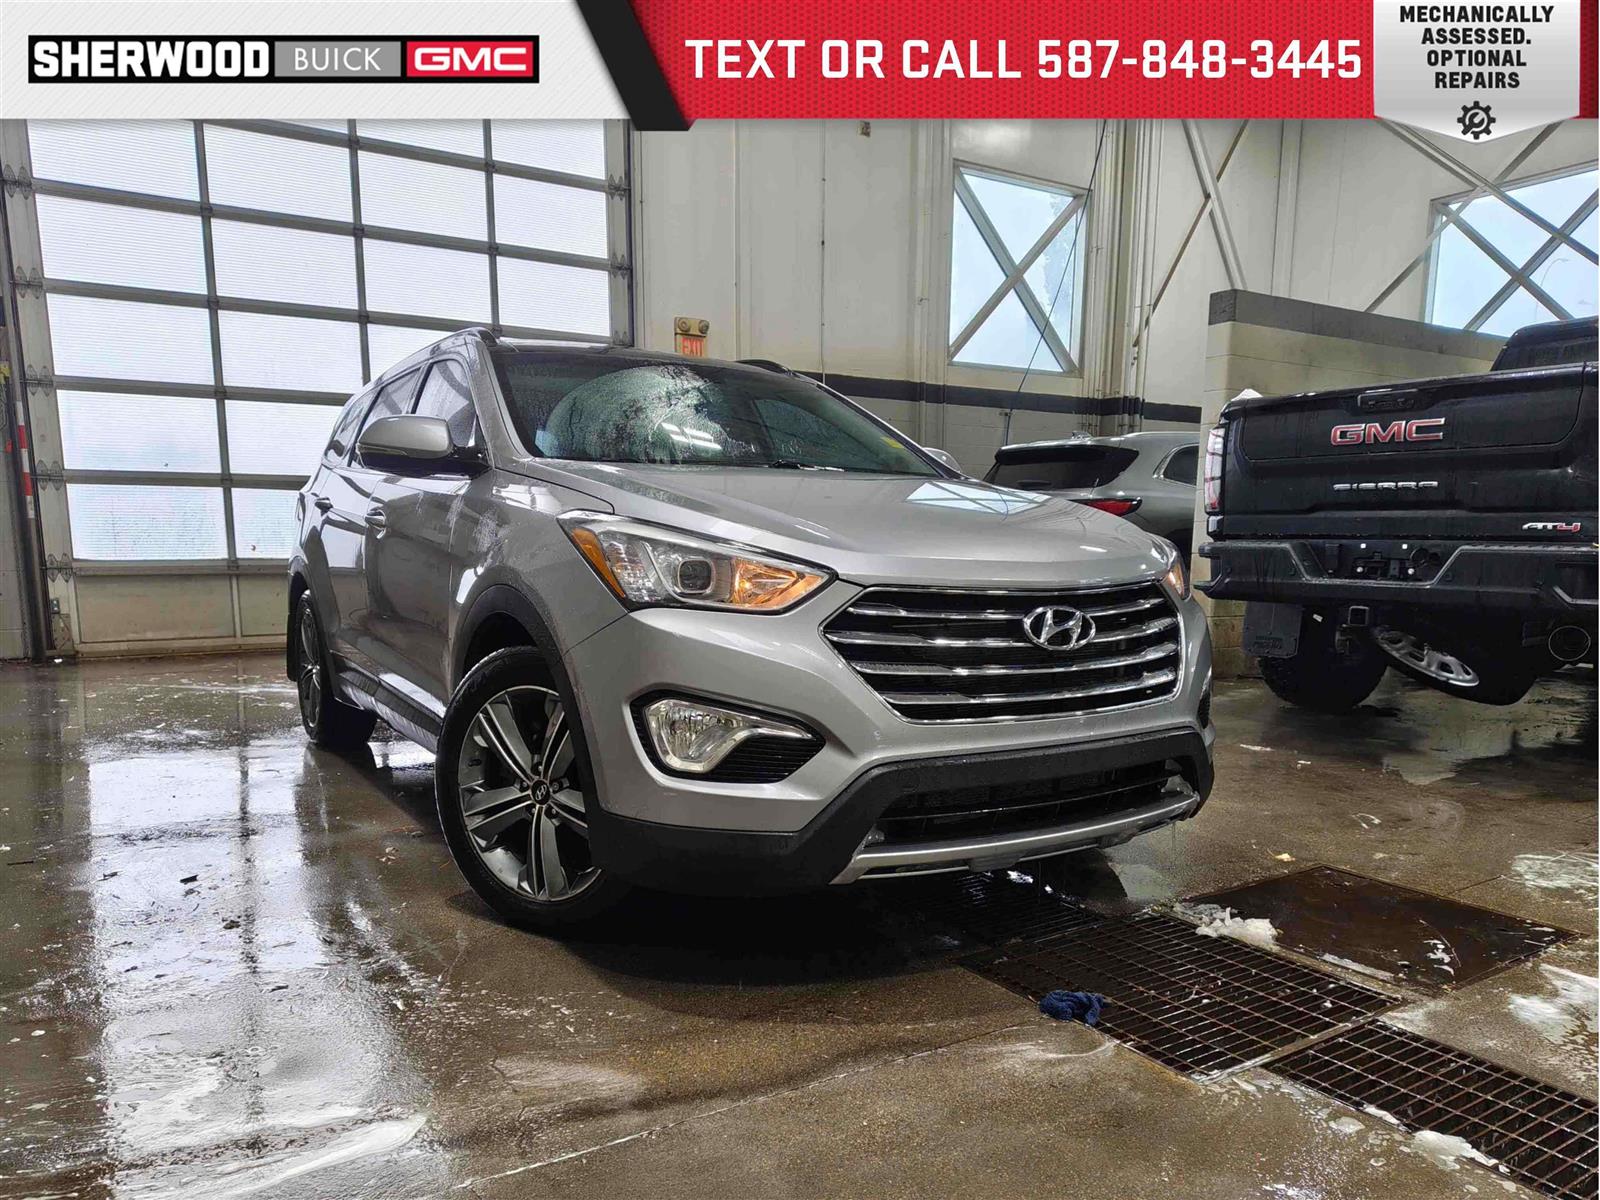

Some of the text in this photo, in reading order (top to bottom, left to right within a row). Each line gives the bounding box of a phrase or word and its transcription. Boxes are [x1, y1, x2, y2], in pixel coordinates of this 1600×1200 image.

[681, 337, 704, 357] EXIT
[1331, 418, 1445, 445] GMC
[1522, 522, 1581, 532] AT4
